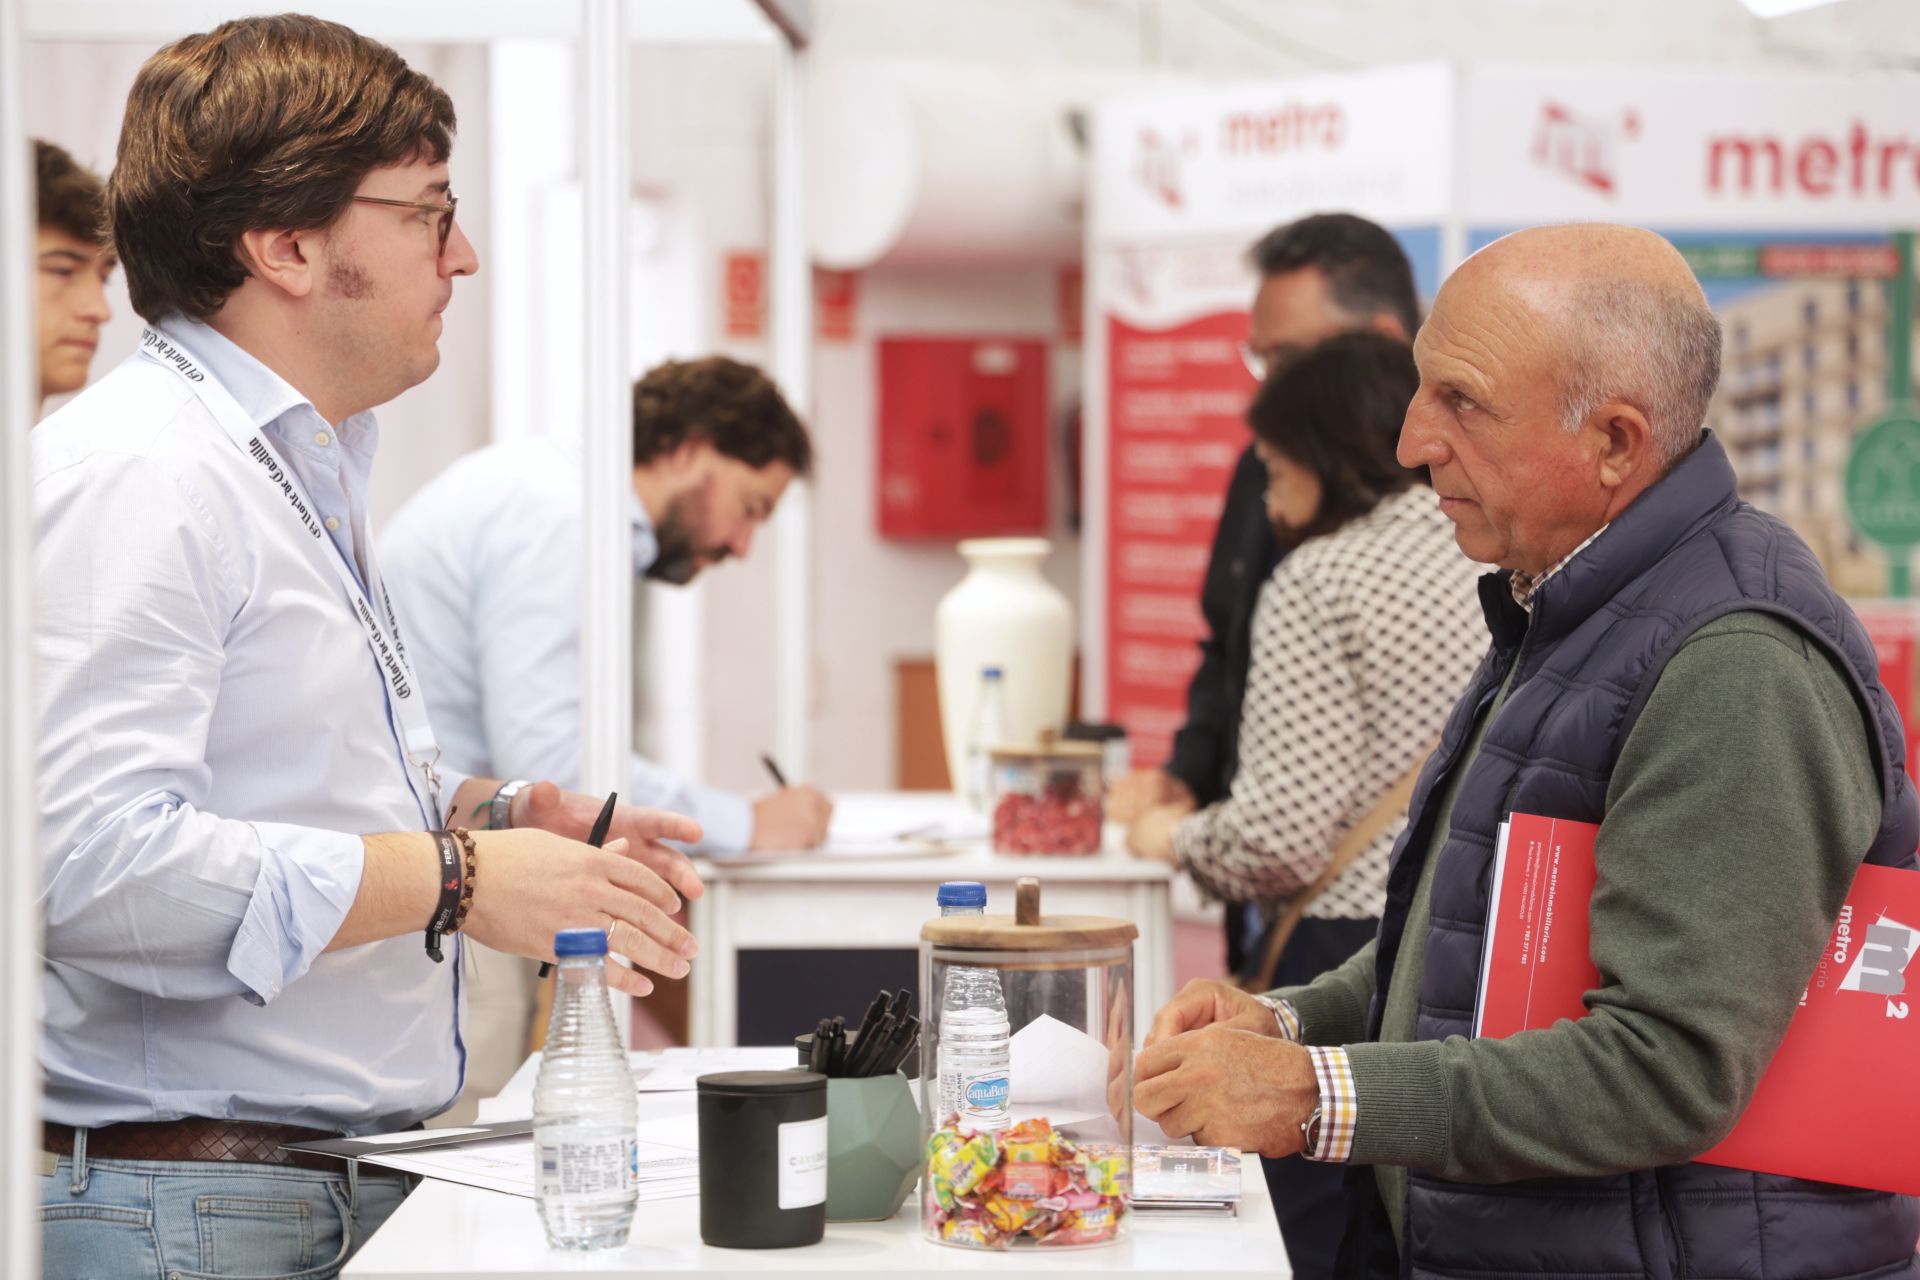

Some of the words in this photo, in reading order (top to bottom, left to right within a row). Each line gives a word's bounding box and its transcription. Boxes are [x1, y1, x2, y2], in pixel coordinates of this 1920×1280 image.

[249, 437, 284, 482] Castilla
[281, 480, 292, 497] de
[290, 492, 311, 524] Norte
[385, 653, 404, 687] Norte
[1540, 845, 1561, 963] www.metroinmobiliaria.com
[1834, 905, 1853, 964] metro
